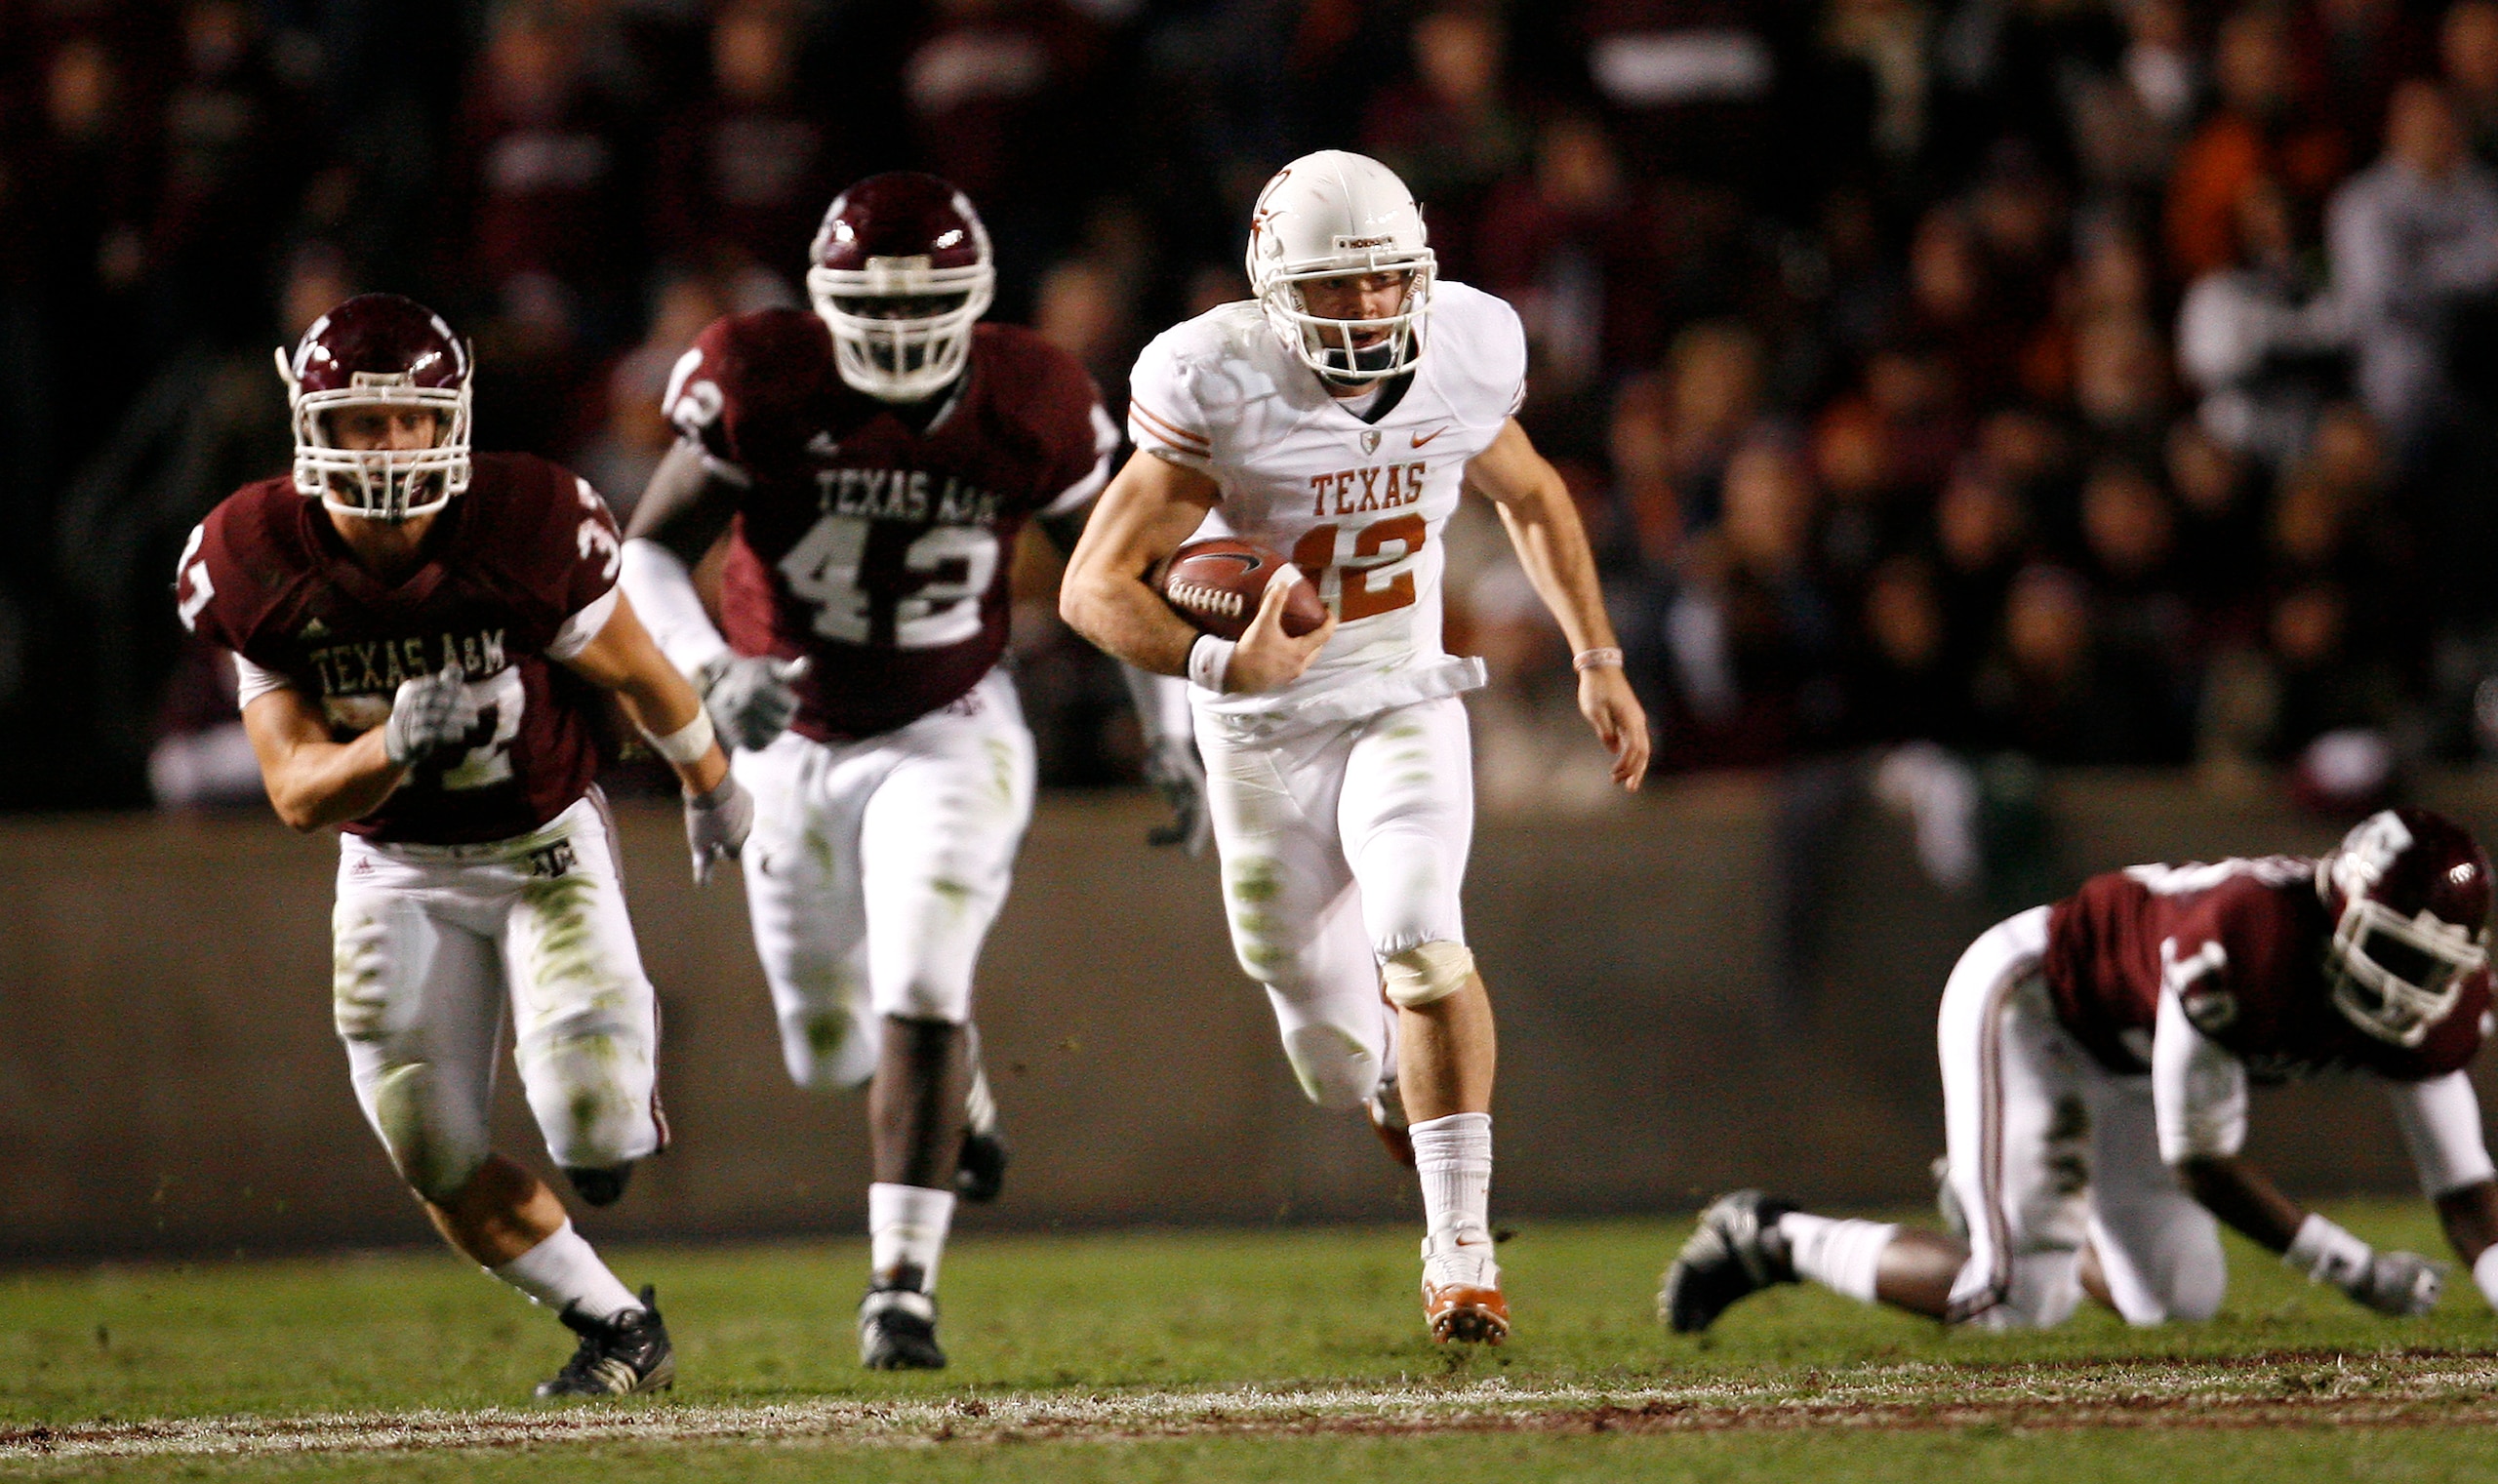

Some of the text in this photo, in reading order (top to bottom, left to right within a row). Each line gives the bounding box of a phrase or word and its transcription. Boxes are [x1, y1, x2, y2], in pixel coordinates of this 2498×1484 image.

[816, 467, 930, 521] TEXAS
[1310, 461, 1426, 516] TEXAS
[780, 516, 1000, 649] 42
[1293, 511, 1426, 622] 12
[308, 627, 505, 695] TEXAS A&M
